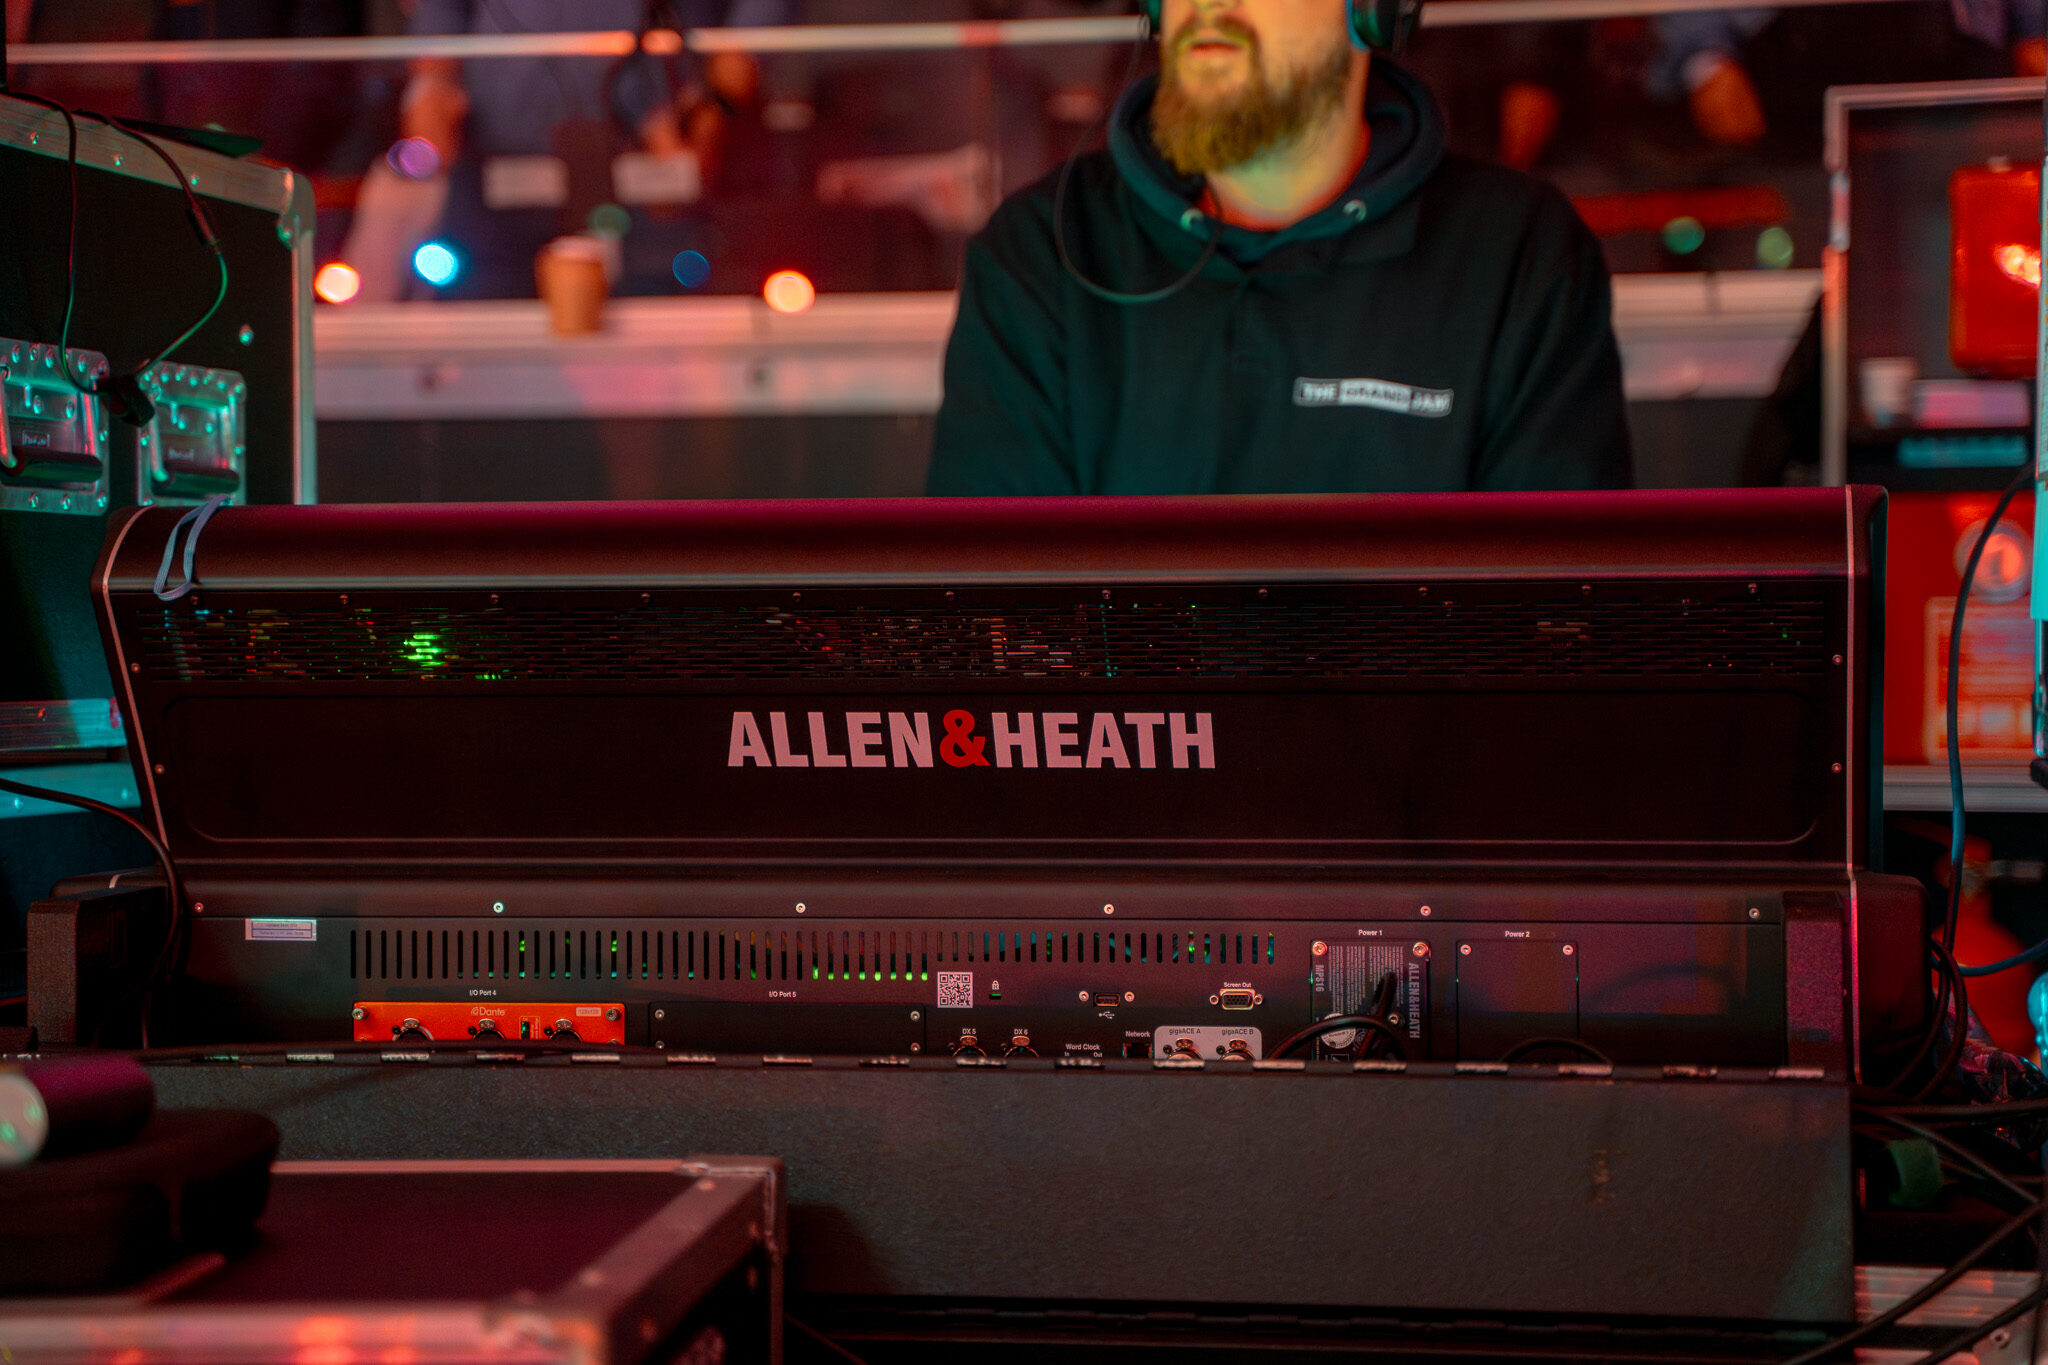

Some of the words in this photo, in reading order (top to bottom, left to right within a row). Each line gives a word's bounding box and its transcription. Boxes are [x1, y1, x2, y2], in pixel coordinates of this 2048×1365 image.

[1302, 383, 1338, 400] THE
[727, 709, 1216, 769] ALLEN&HEATH
[1505, 930, 1525, 938] Power
[1315, 964, 1325, 992] MPS16
[768, 990, 778, 998] I/O
[1408, 963, 1420, 1039] ALLEN&HEATH
[480, 1006, 506, 1016] Dante
[1125, 1030, 1151, 1038] Network
[1169, 1028, 1195, 1036] gigaACE
[1221, 1028, 1248, 1036] gigaACE
